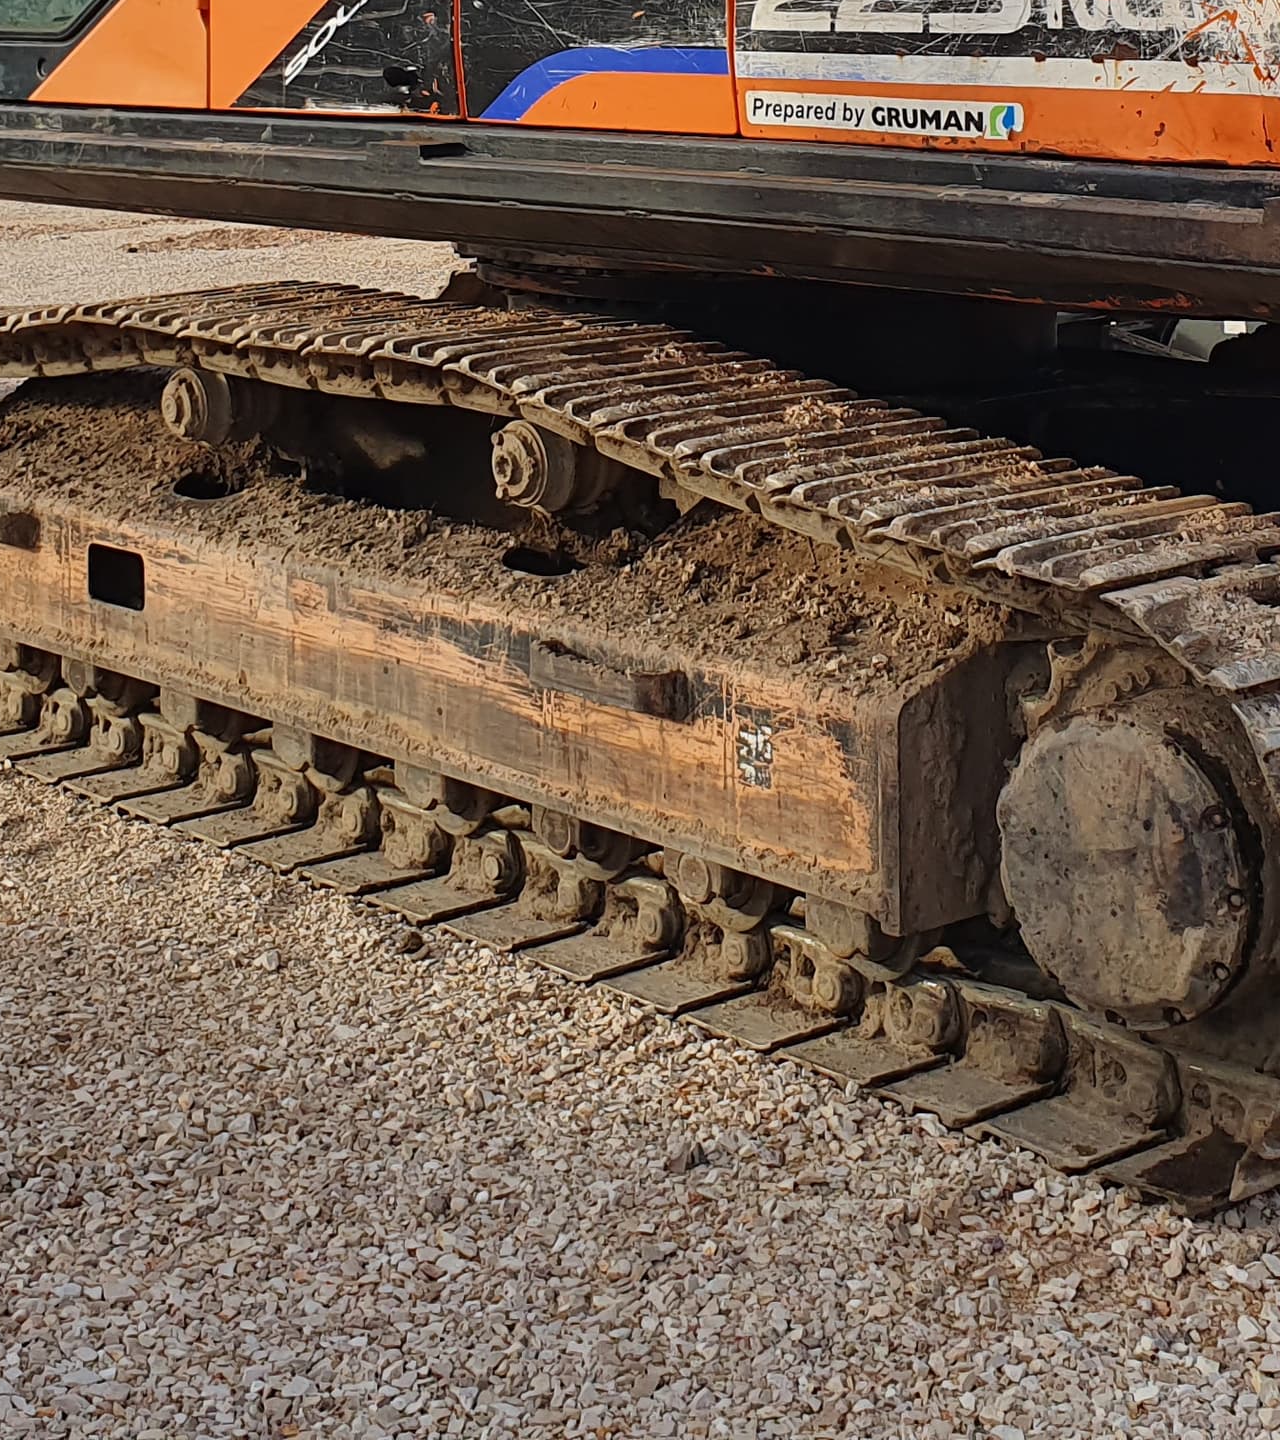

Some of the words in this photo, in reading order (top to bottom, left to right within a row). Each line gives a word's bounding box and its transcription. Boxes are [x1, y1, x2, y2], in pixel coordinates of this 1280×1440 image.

[752, 98, 836, 121] Prepared
[842, 103, 865, 127] by
[871, 106, 984, 132] GRUMAN
